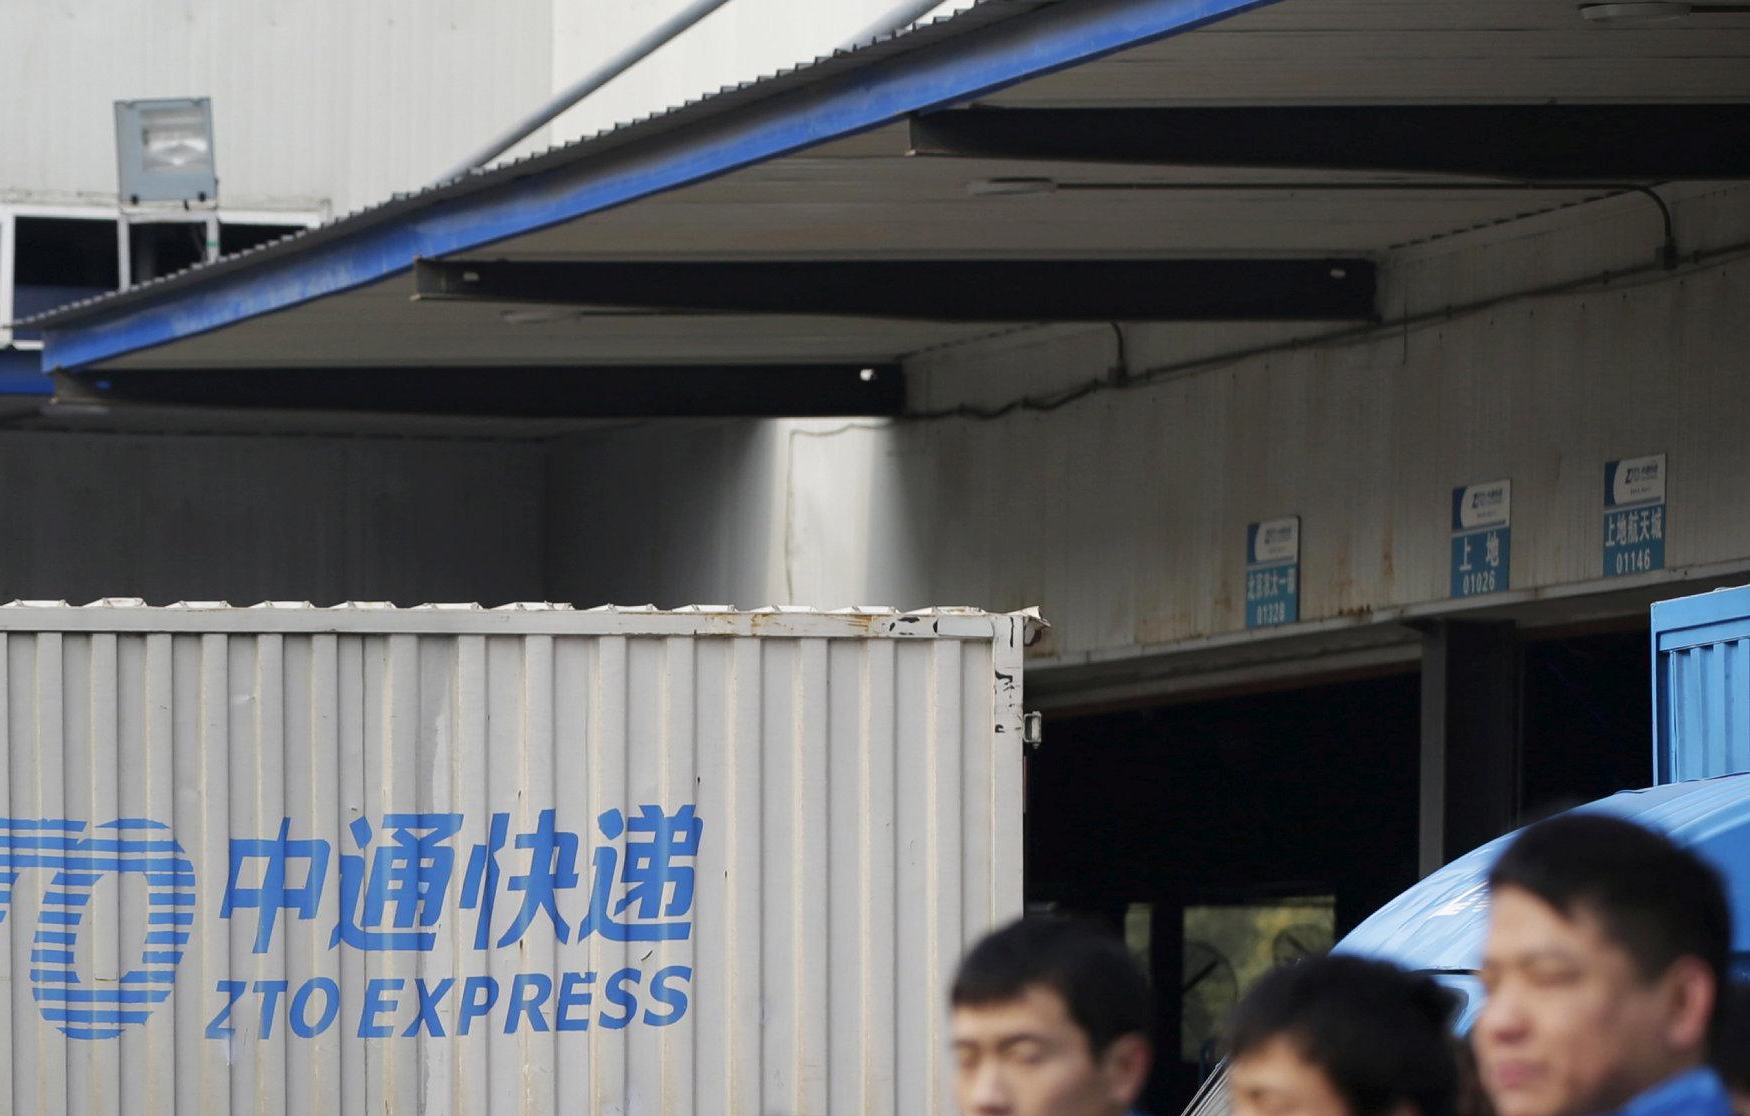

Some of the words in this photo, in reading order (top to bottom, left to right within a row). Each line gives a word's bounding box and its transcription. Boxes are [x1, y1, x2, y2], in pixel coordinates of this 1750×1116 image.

[1606, 507, 1662, 546] 上地航天城
[1459, 530, 1499, 572] 上地
[1616, 547, 1651, 575] 01146
[1463, 569, 1496, 595] 01026
[220, 804, 703, 954] 中通快递
[206, 974, 340, 1039] ZTO
[357, 964, 692, 1038] EXPRESS
